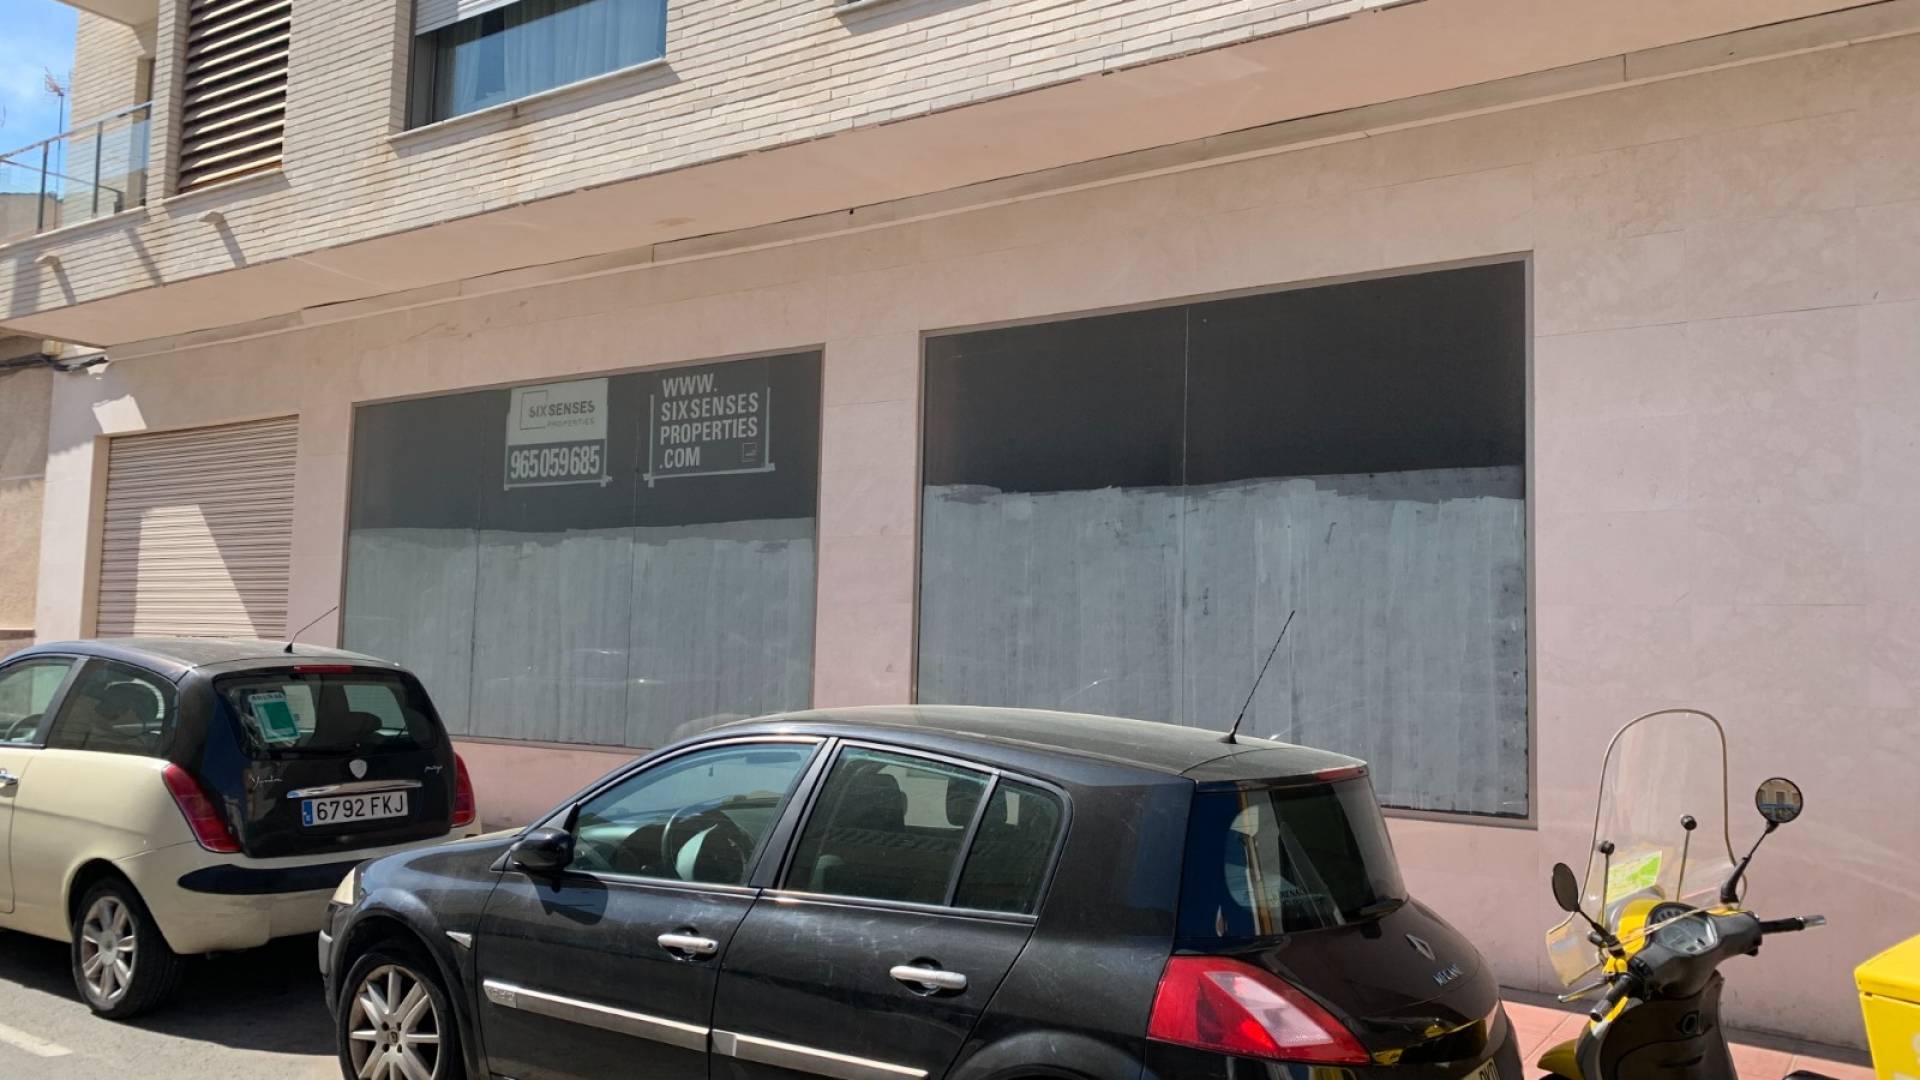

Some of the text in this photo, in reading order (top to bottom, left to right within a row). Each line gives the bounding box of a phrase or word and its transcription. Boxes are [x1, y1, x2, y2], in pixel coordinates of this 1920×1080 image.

[662, 373, 717, 397] WWW.
[529, 400, 595, 418] SIXSENSES
[661, 392, 758, 421] SIXSENSES
[660, 417, 757, 445] PROPERTIES
[511, 445, 600, 478] 965059685
[659, 446, 700, 468] .COM
[316, 794, 403, 820] 6792 FKJ
